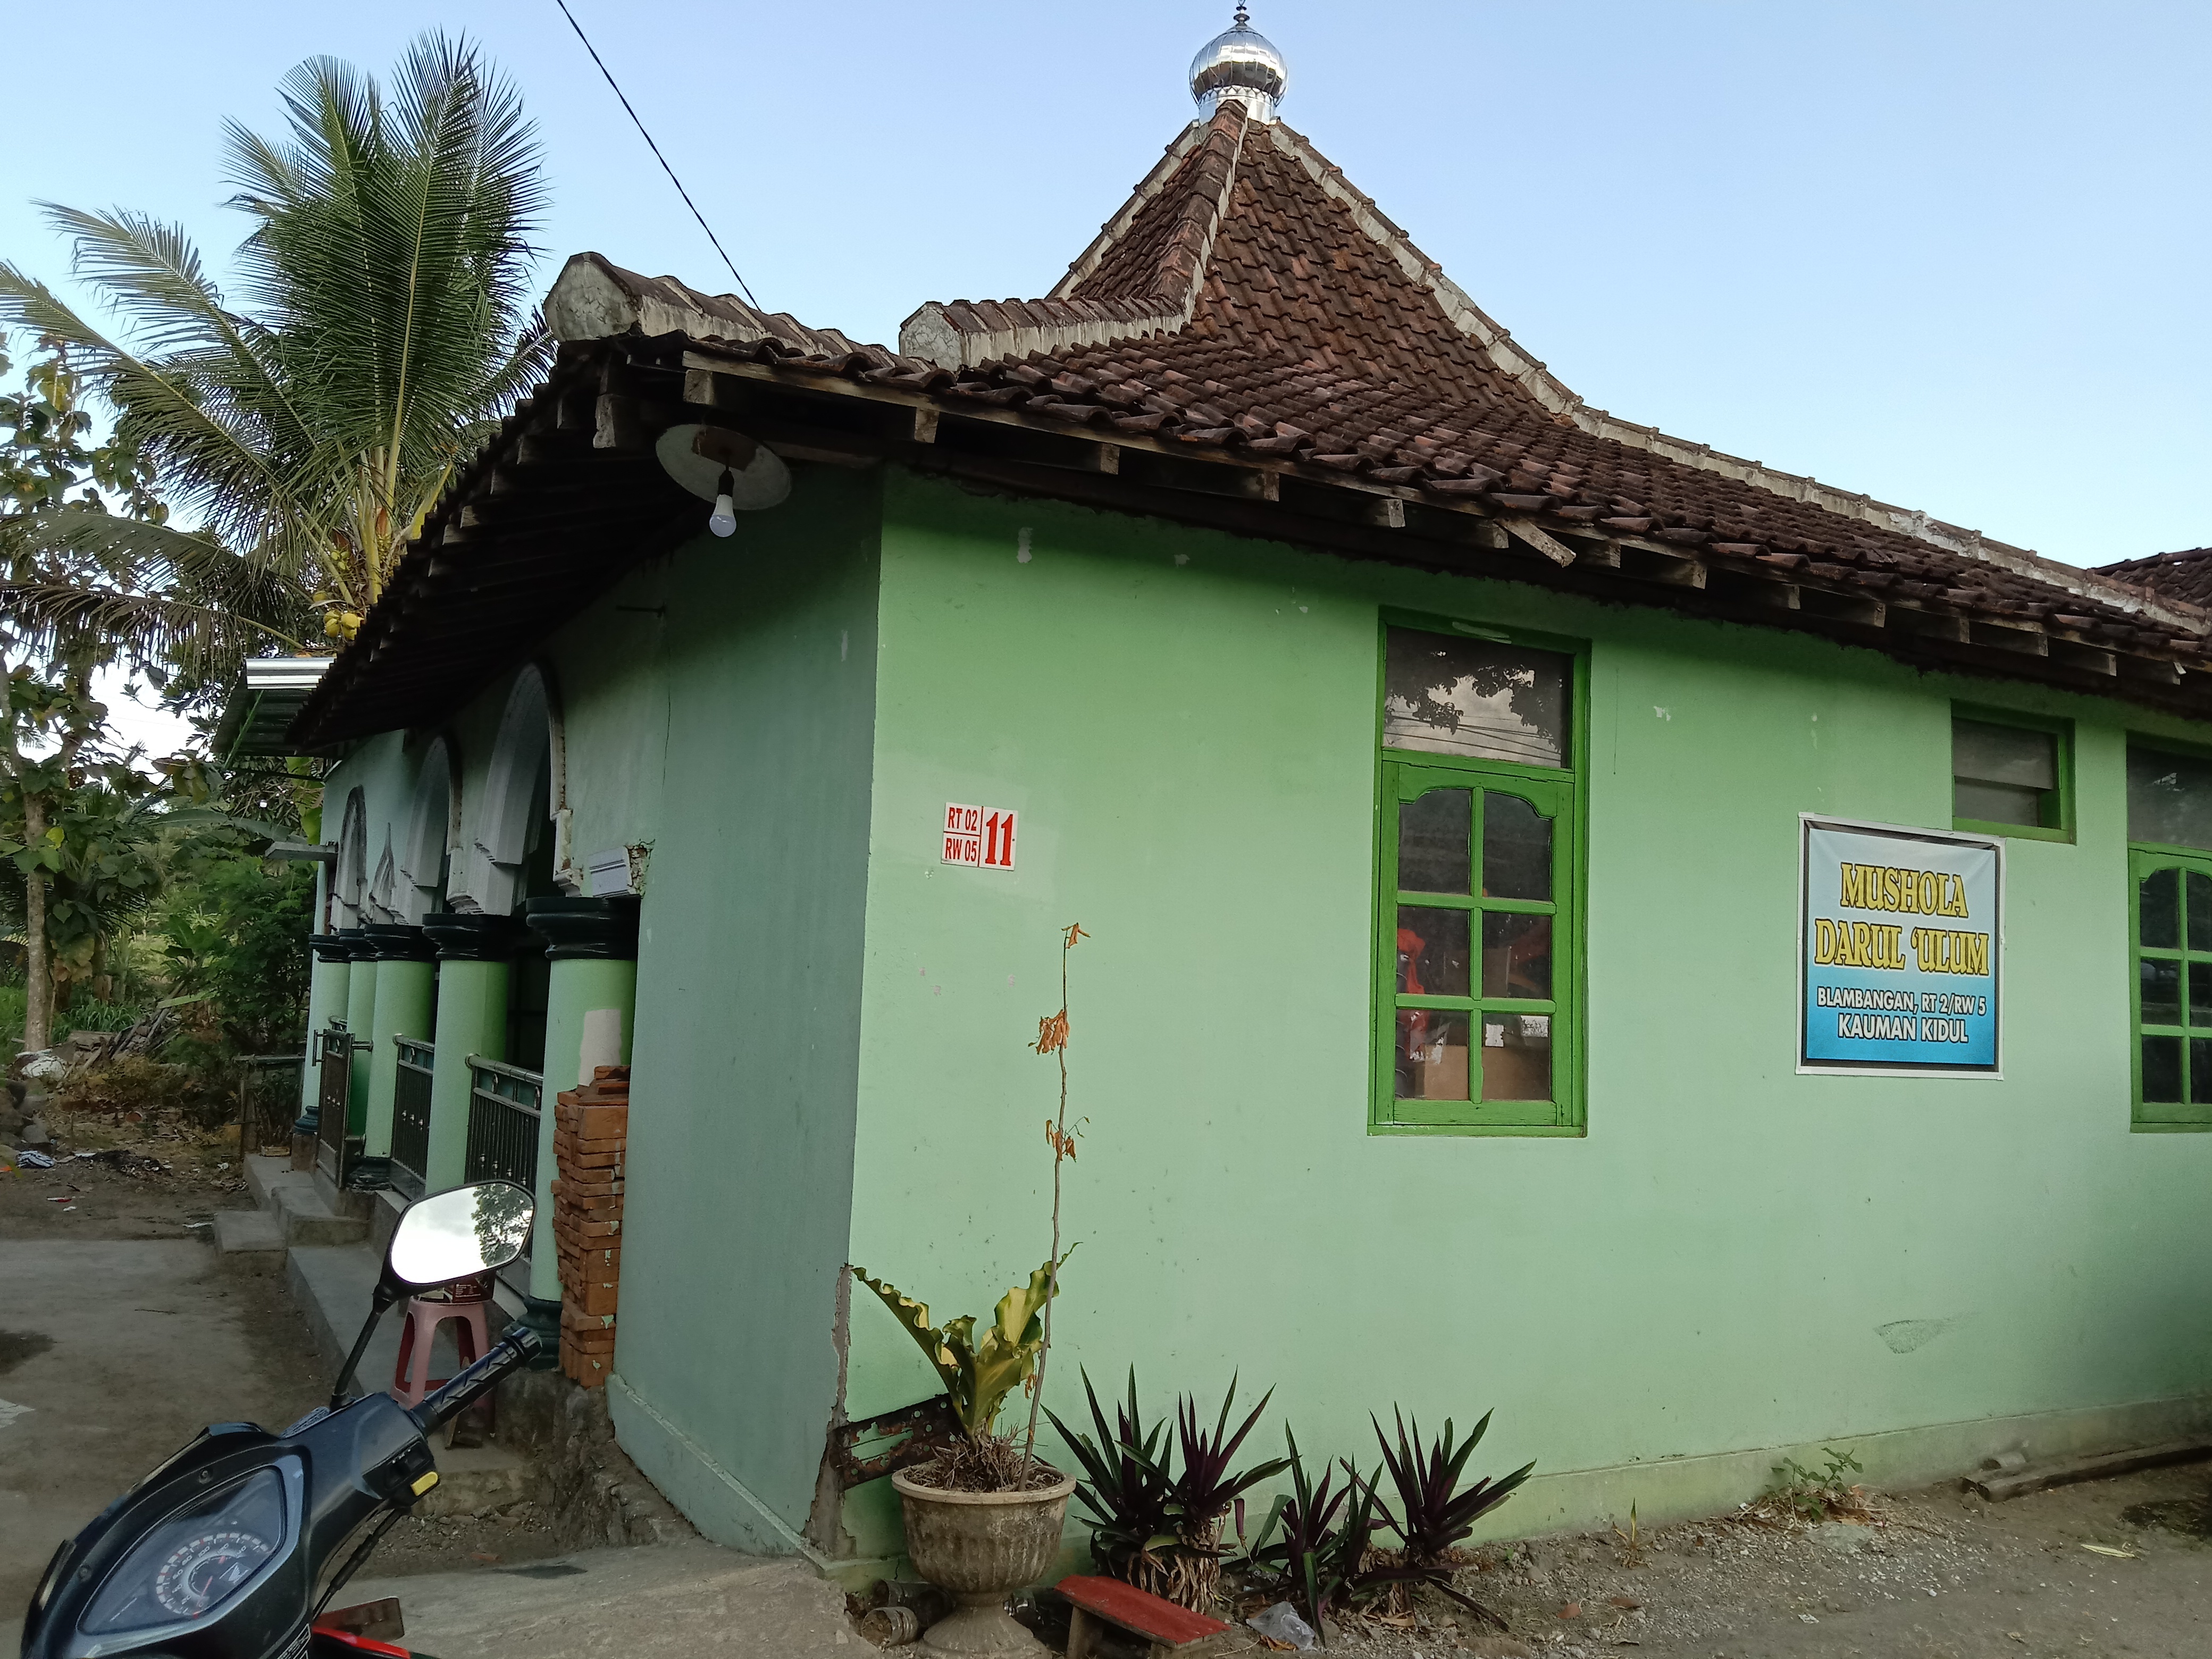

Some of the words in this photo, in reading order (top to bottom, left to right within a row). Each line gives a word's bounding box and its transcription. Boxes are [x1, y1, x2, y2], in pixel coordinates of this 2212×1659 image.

[948, 807, 962, 828] RT
[965, 809, 977, 831] 02
[945, 838, 962, 859] RW
[965, 840, 977, 861] 05
[985, 812, 1013, 866] 11
[1840, 862, 1968, 918] MUSHOLA
[1815, 919, 1906, 970] DARUL
[1817, 986, 1918, 1014] BLAMBANGAN,
[1921, 993, 1937, 1012] RT
[1940, 993, 1975, 1015] 2/RW
[1978, 996, 1987, 1016] 5
[1838, 1013, 1916, 1041] KAUMAN
[1921, 1017, 1968, 1043] KIDUL
